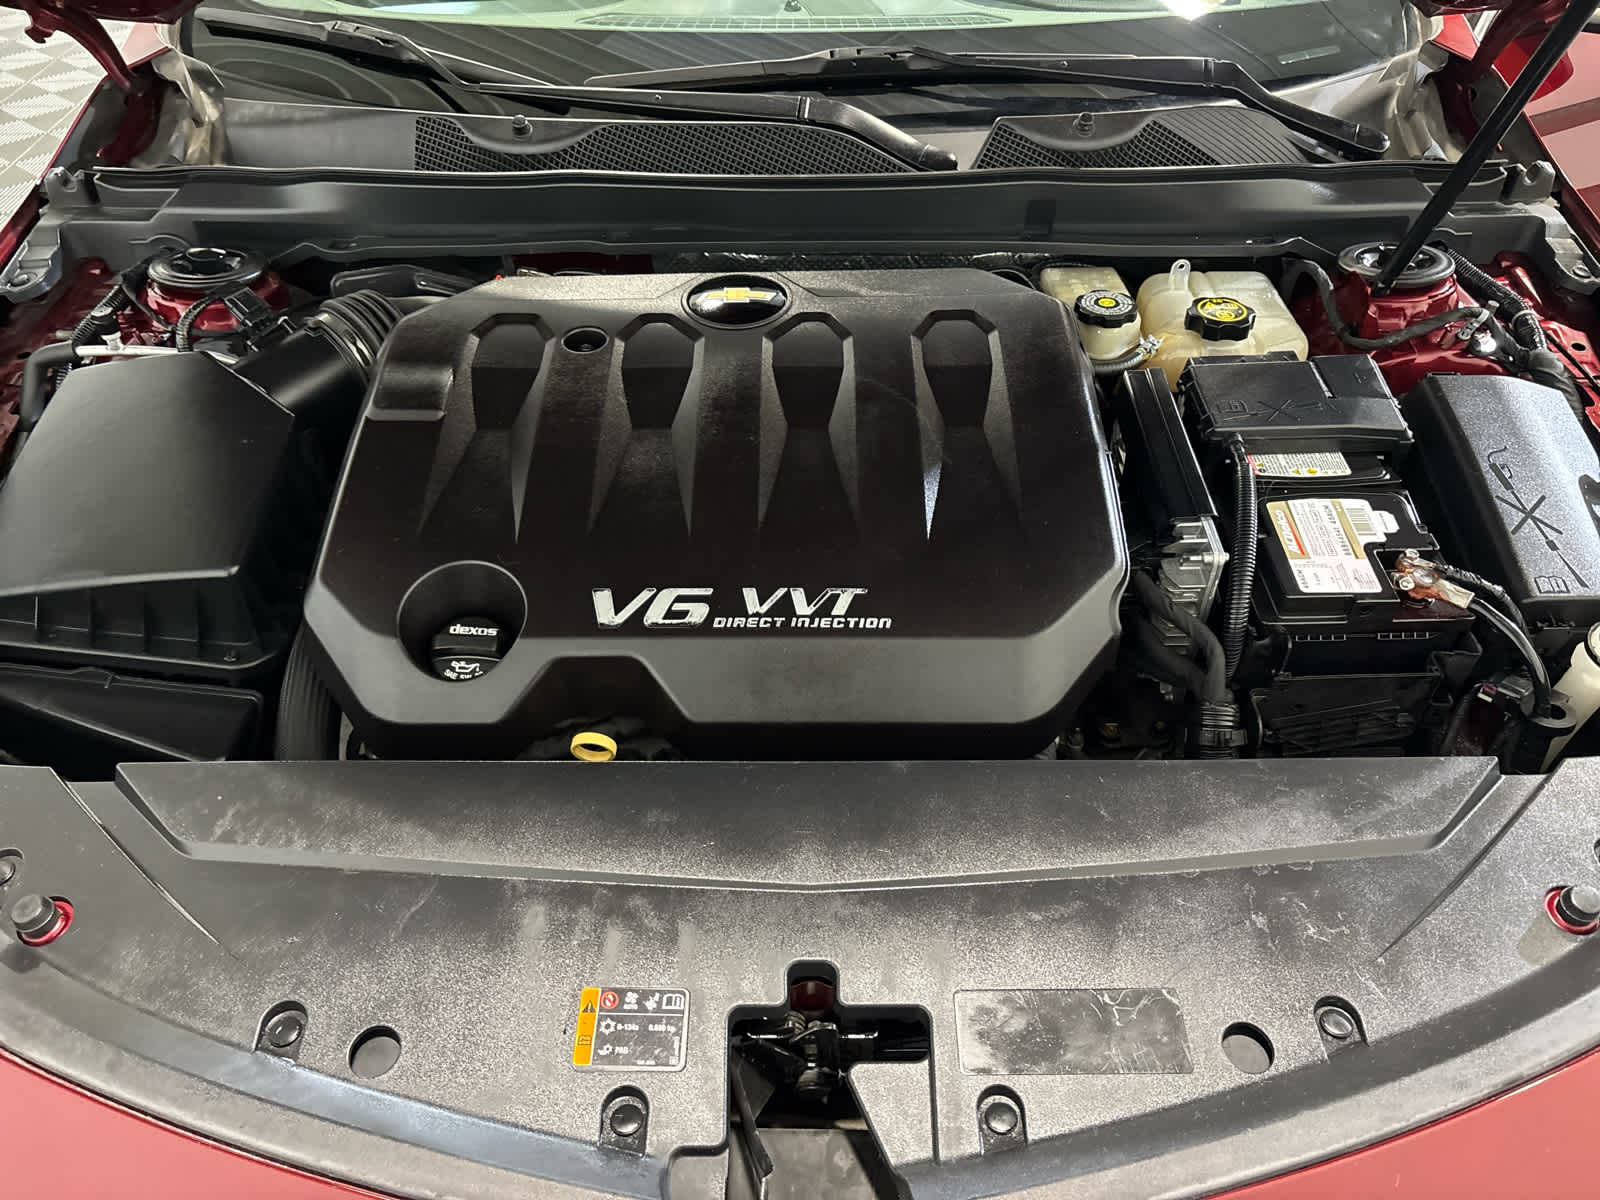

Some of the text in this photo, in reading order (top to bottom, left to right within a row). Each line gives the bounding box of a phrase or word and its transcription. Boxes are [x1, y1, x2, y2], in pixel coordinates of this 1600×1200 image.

[592, 587, 868, 628] V6 VVT
[712, 616, 892, 629] DIRECT INJECTION
[449, 623, 500, 636] dexos
